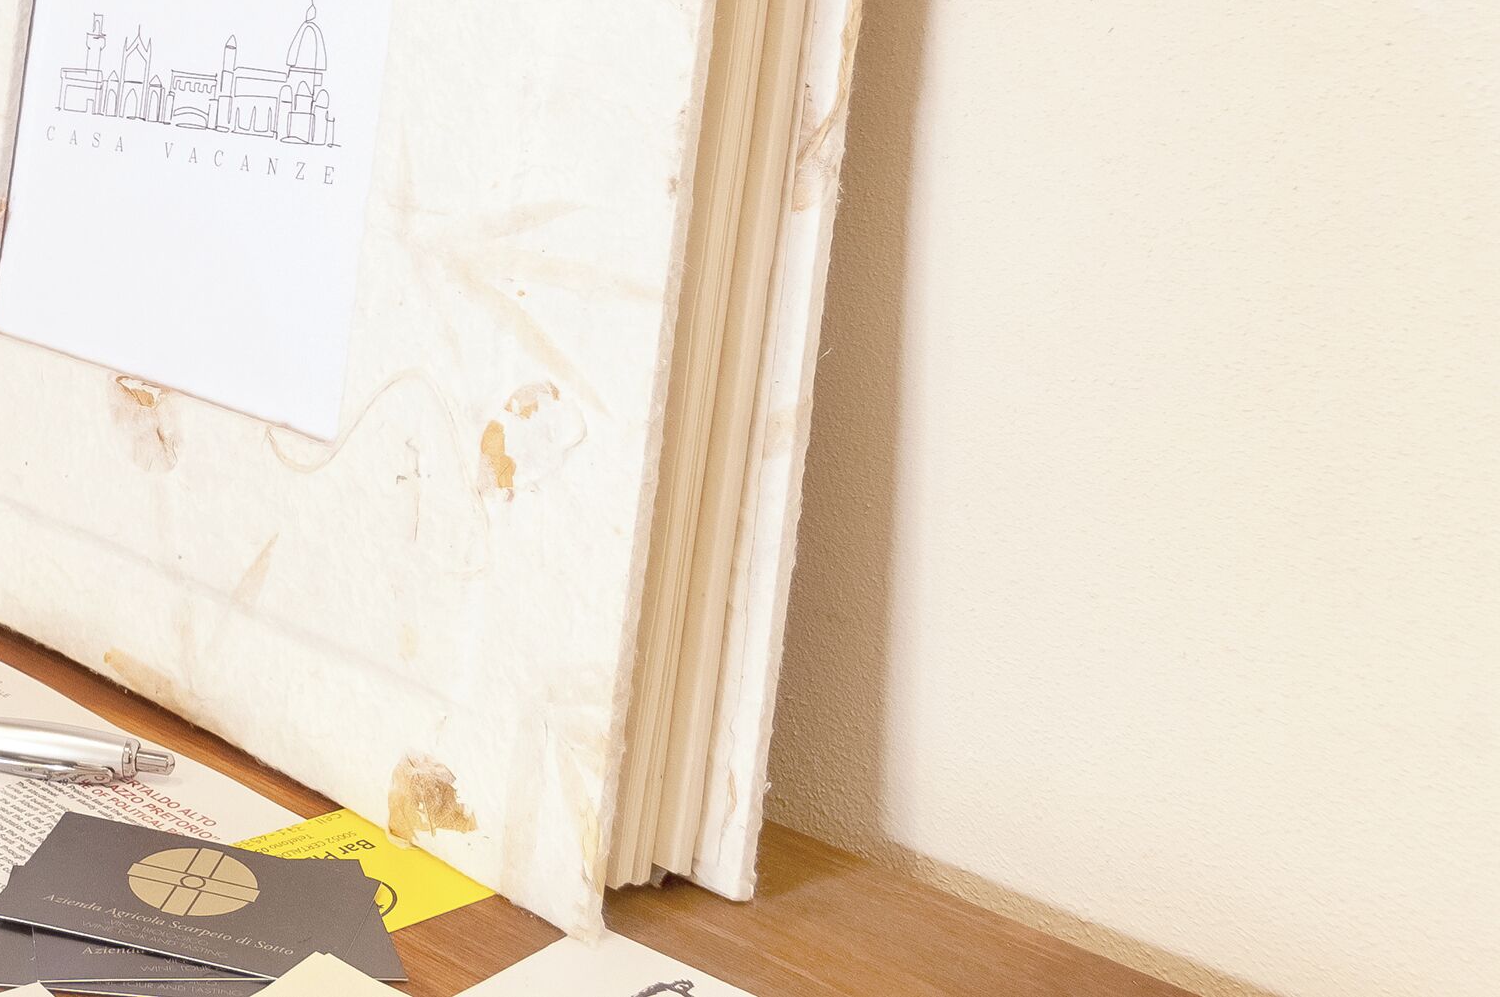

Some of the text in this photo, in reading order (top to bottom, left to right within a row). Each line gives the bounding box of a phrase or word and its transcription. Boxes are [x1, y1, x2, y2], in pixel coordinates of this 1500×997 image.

[46, 126, 335, 185] CASA VACANZE
[92, 789, 164, 829] OF POLITICAL
[120, 777, 180, 808] ERTALDO
[177, 808, 216, 826] ALTO
[338, 839, 376, 855] Bar
[43, 894, 294, 956] Azienda Agricola Scarpeto di Sotto
